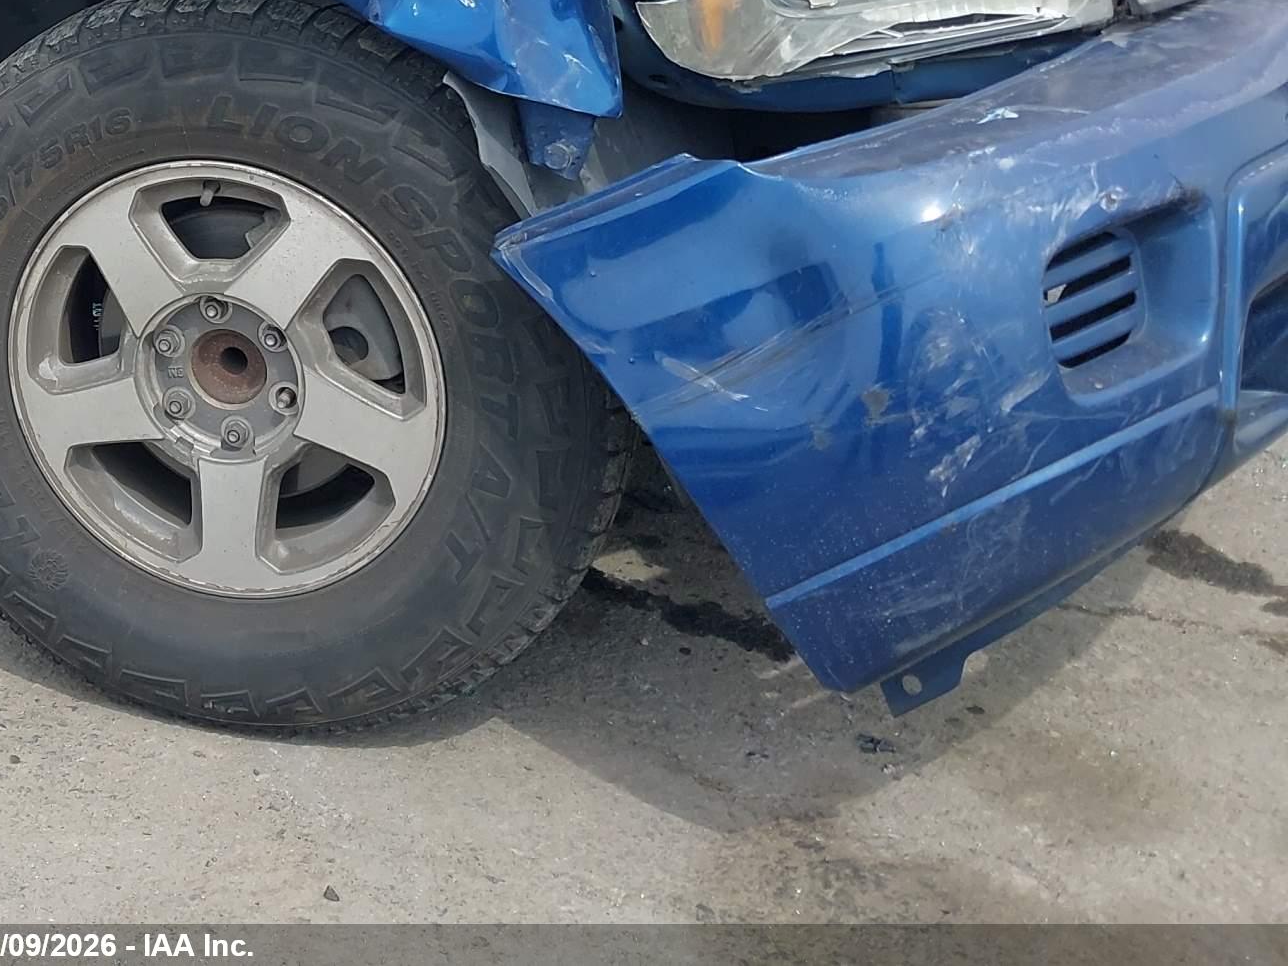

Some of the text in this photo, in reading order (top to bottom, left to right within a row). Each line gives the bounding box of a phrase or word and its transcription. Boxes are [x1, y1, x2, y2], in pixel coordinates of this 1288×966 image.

[205, 93, 520, 586] LION SPORT A/T
